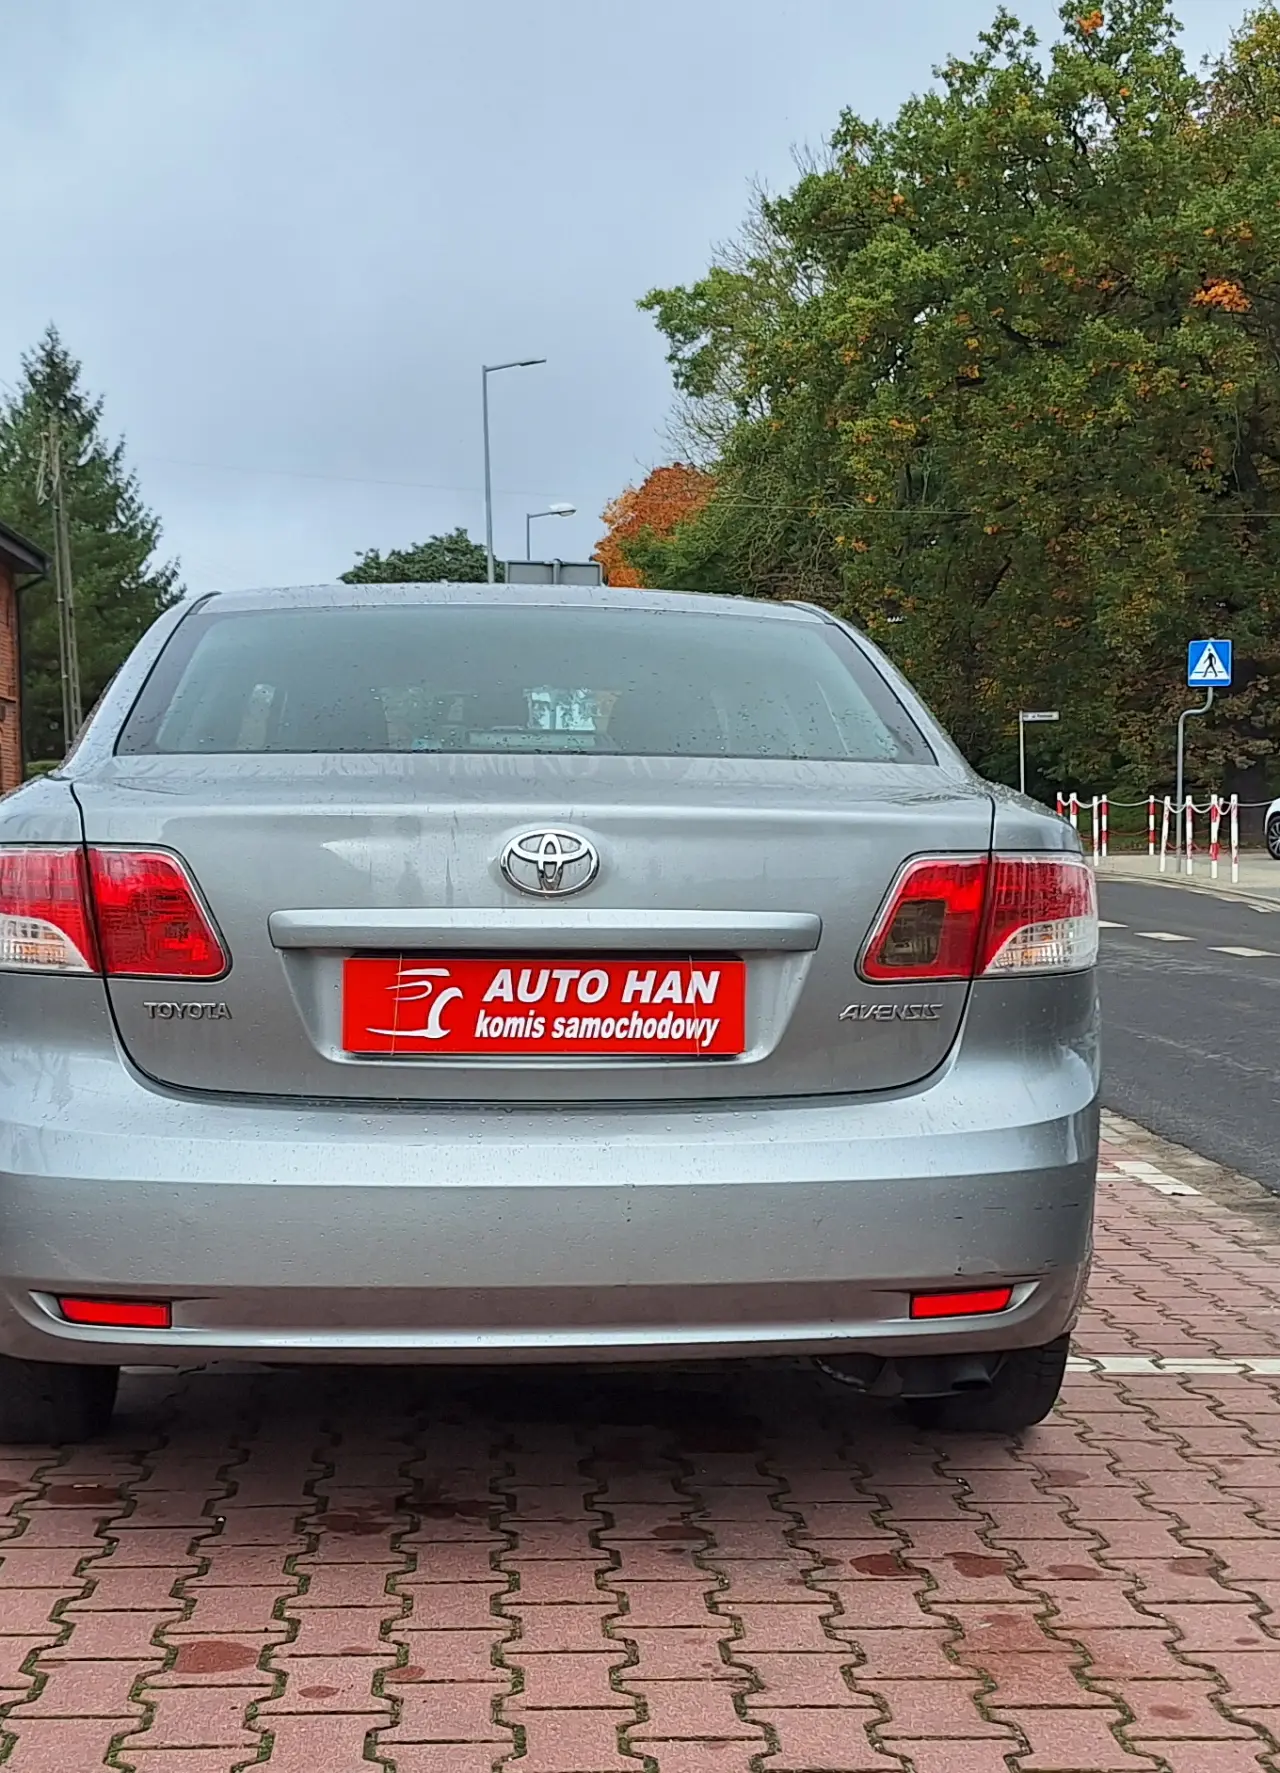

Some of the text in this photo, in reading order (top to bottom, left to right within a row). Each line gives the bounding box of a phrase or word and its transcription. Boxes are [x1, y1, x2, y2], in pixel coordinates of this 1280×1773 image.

[484, 969, 720, 1004] AUTO HAN
[143, 1001, 232, 1020] TOYOTA
[839, 1003, 943, 1021] AVENSIS
[474, 1009, 720, 1046] komis samochodowy
